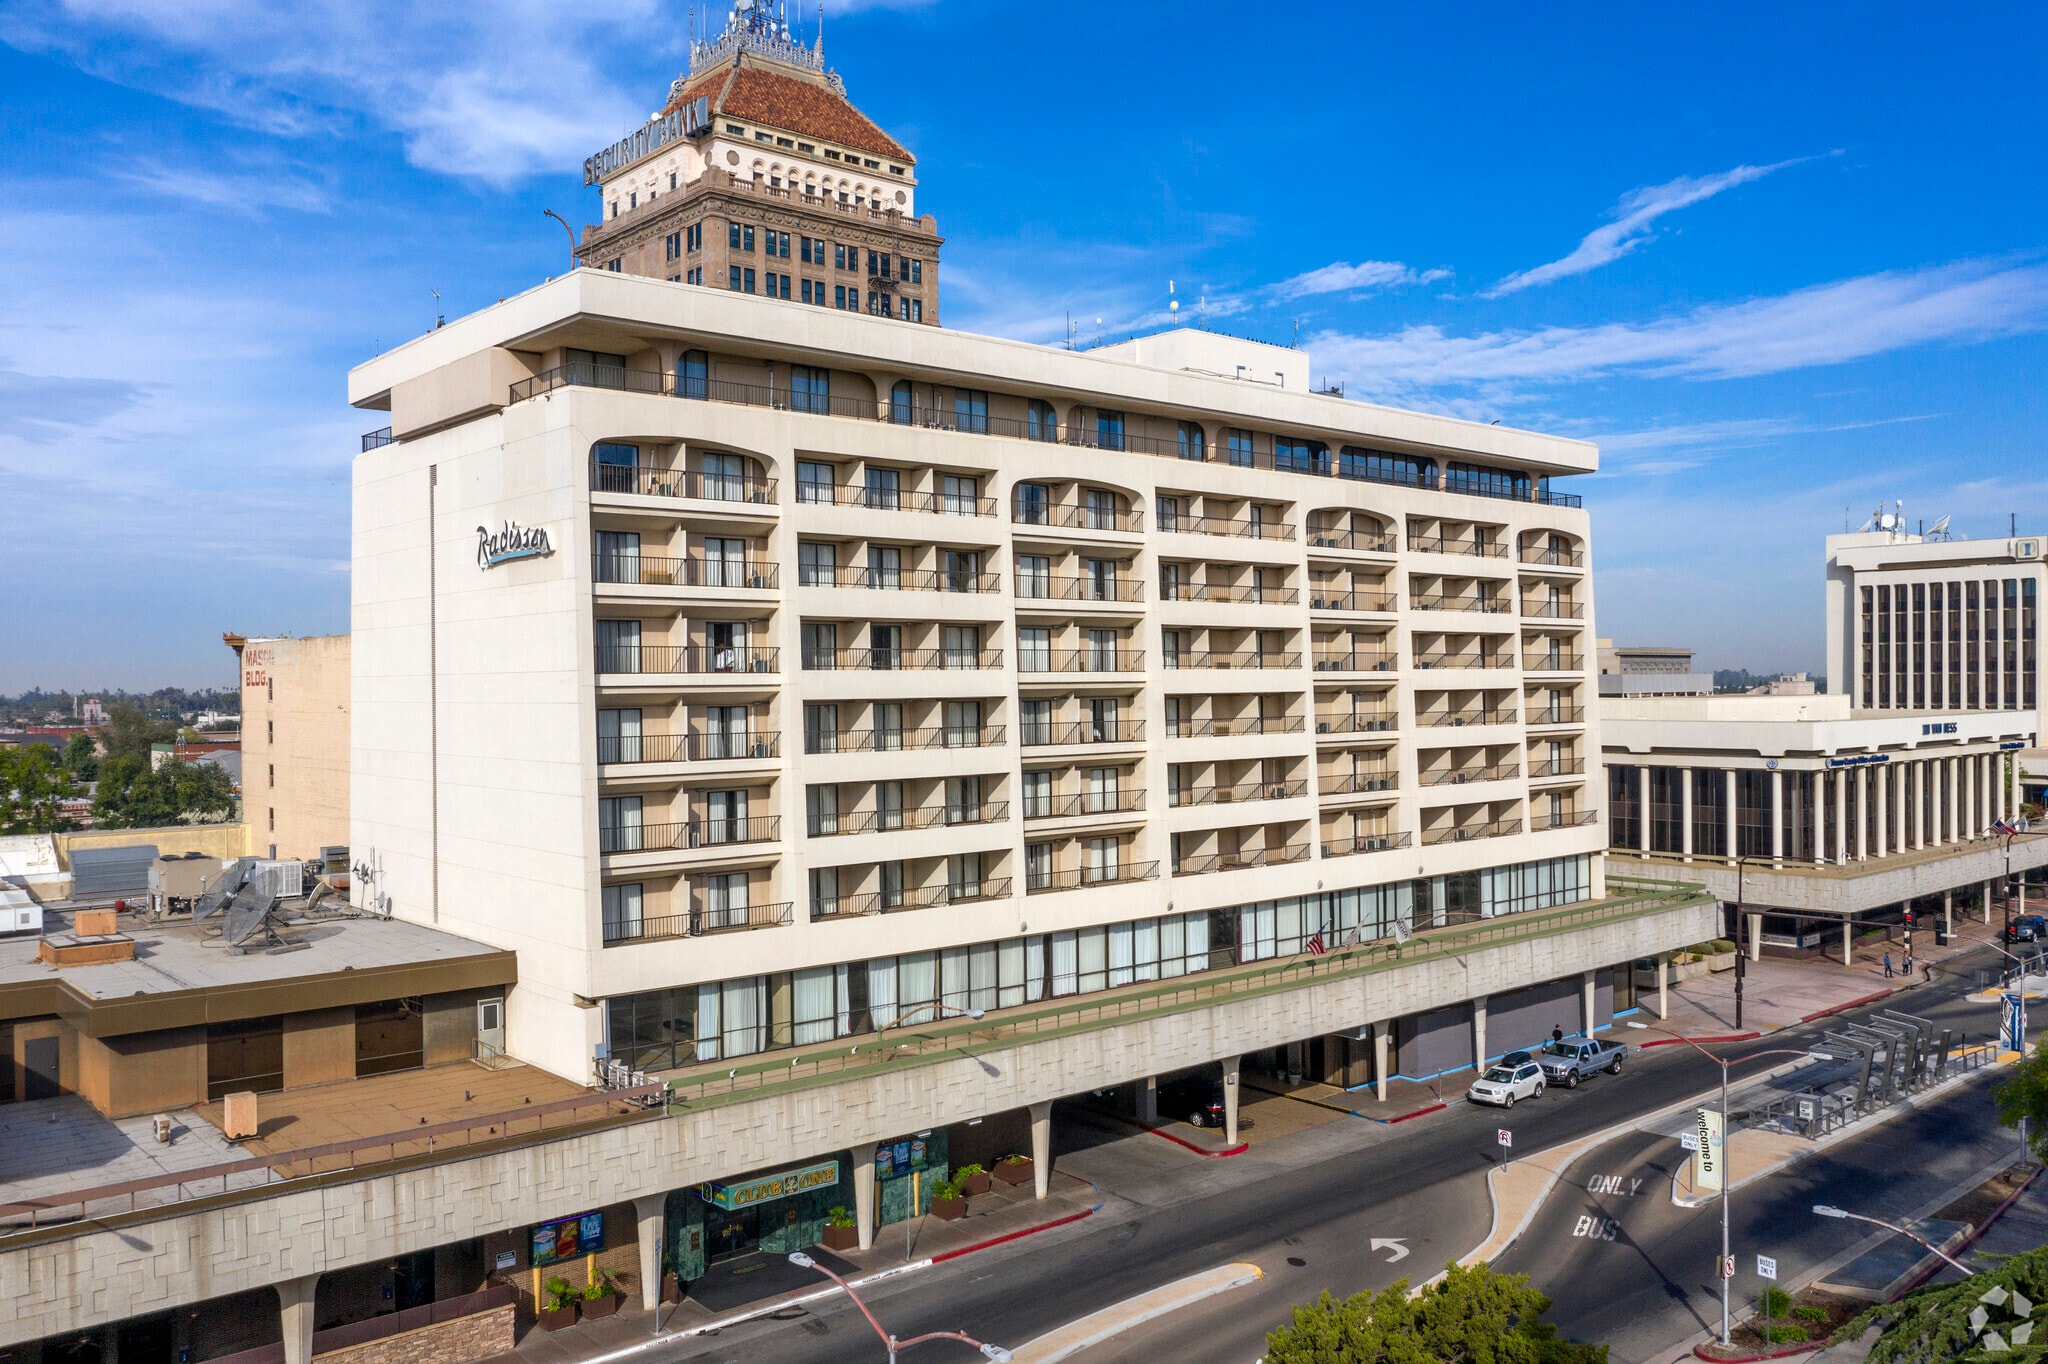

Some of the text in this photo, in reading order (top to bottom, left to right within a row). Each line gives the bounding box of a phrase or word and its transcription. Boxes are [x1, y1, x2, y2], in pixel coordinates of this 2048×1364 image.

[583, 96, 708, 187] SECURITY BANK
[476, 519, 551, 569] Radisson
[246, 670, 268, 687] BLDG.
[1943, 722, 1958, 734] NESS
[1682, 1134, 1698, 1143] BUSES
[1683, 1140, 1698, 1149] ONLY
[1698, 1111, 1713, 1172] welcome to
[734, 1167, 835, 1205] CLUB ONE
[1587, 1174, 1643, 1197] ONLY
[1572, 1215, 1620, 1242] BUS
[1759, 1258, 1774, 1269] BUSES
[1760, 1266, 1773, 1276] ONLY
